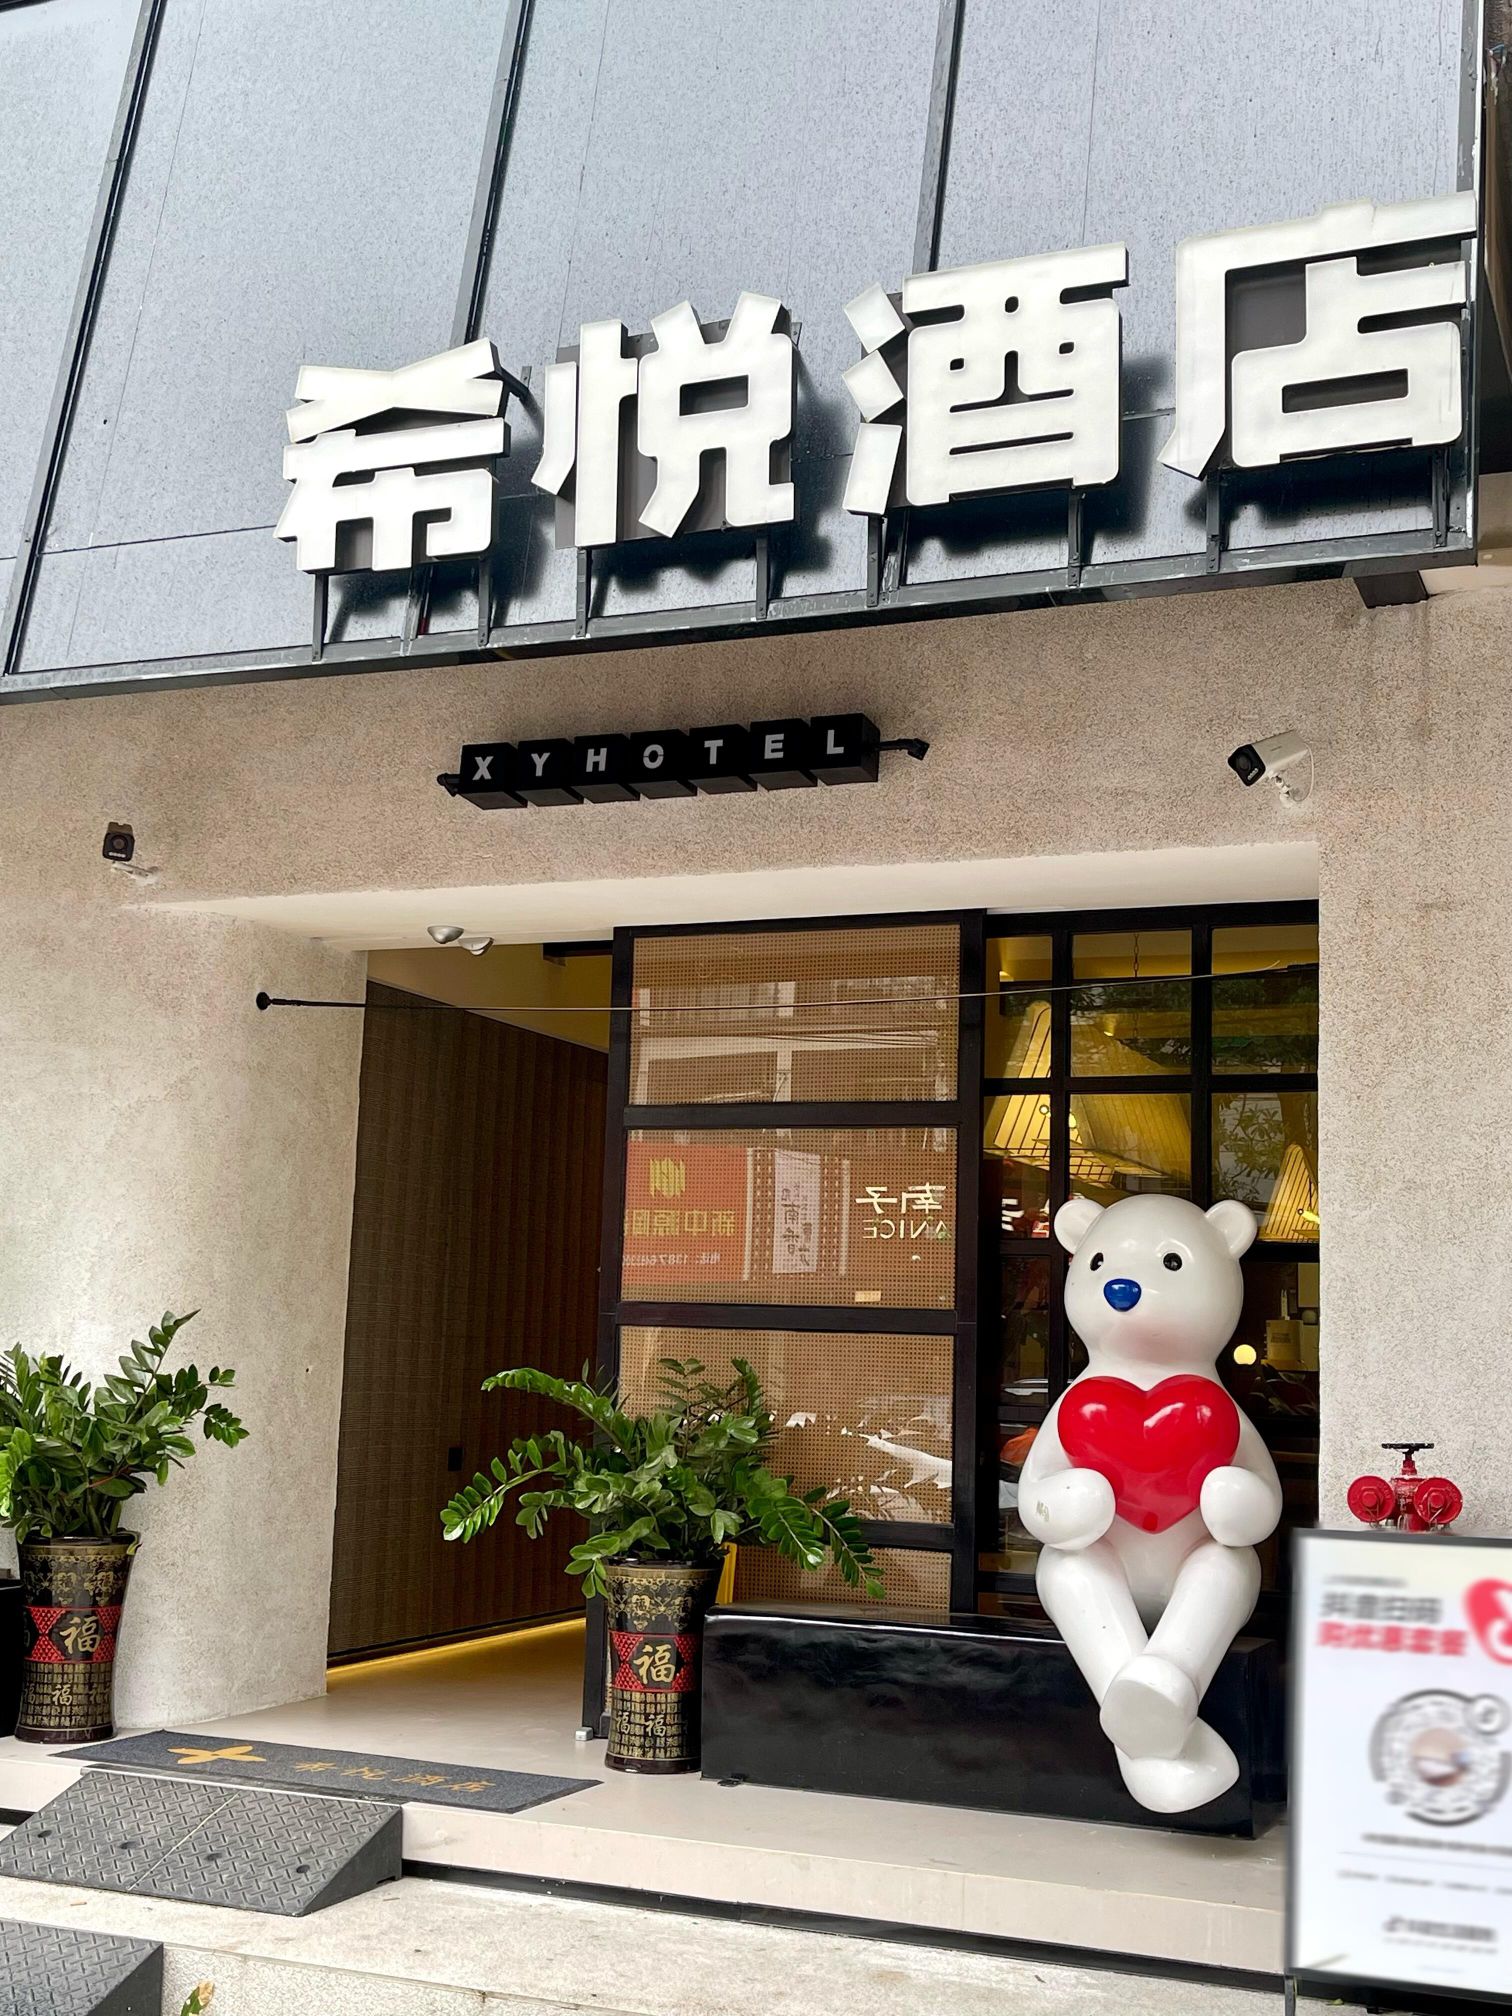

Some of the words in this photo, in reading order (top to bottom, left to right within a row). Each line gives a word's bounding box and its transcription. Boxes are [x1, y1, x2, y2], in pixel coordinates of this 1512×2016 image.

[273, 193, 1478, 574] 希悦酒店
[59, 1615, 100, 1654] 福
[633, 1644, 676, 1684] 福
[51, 1684, 72, 1705] 福
[615, 1711, 630, 1734] 福
[645, 1714, 667, 1737] 福
